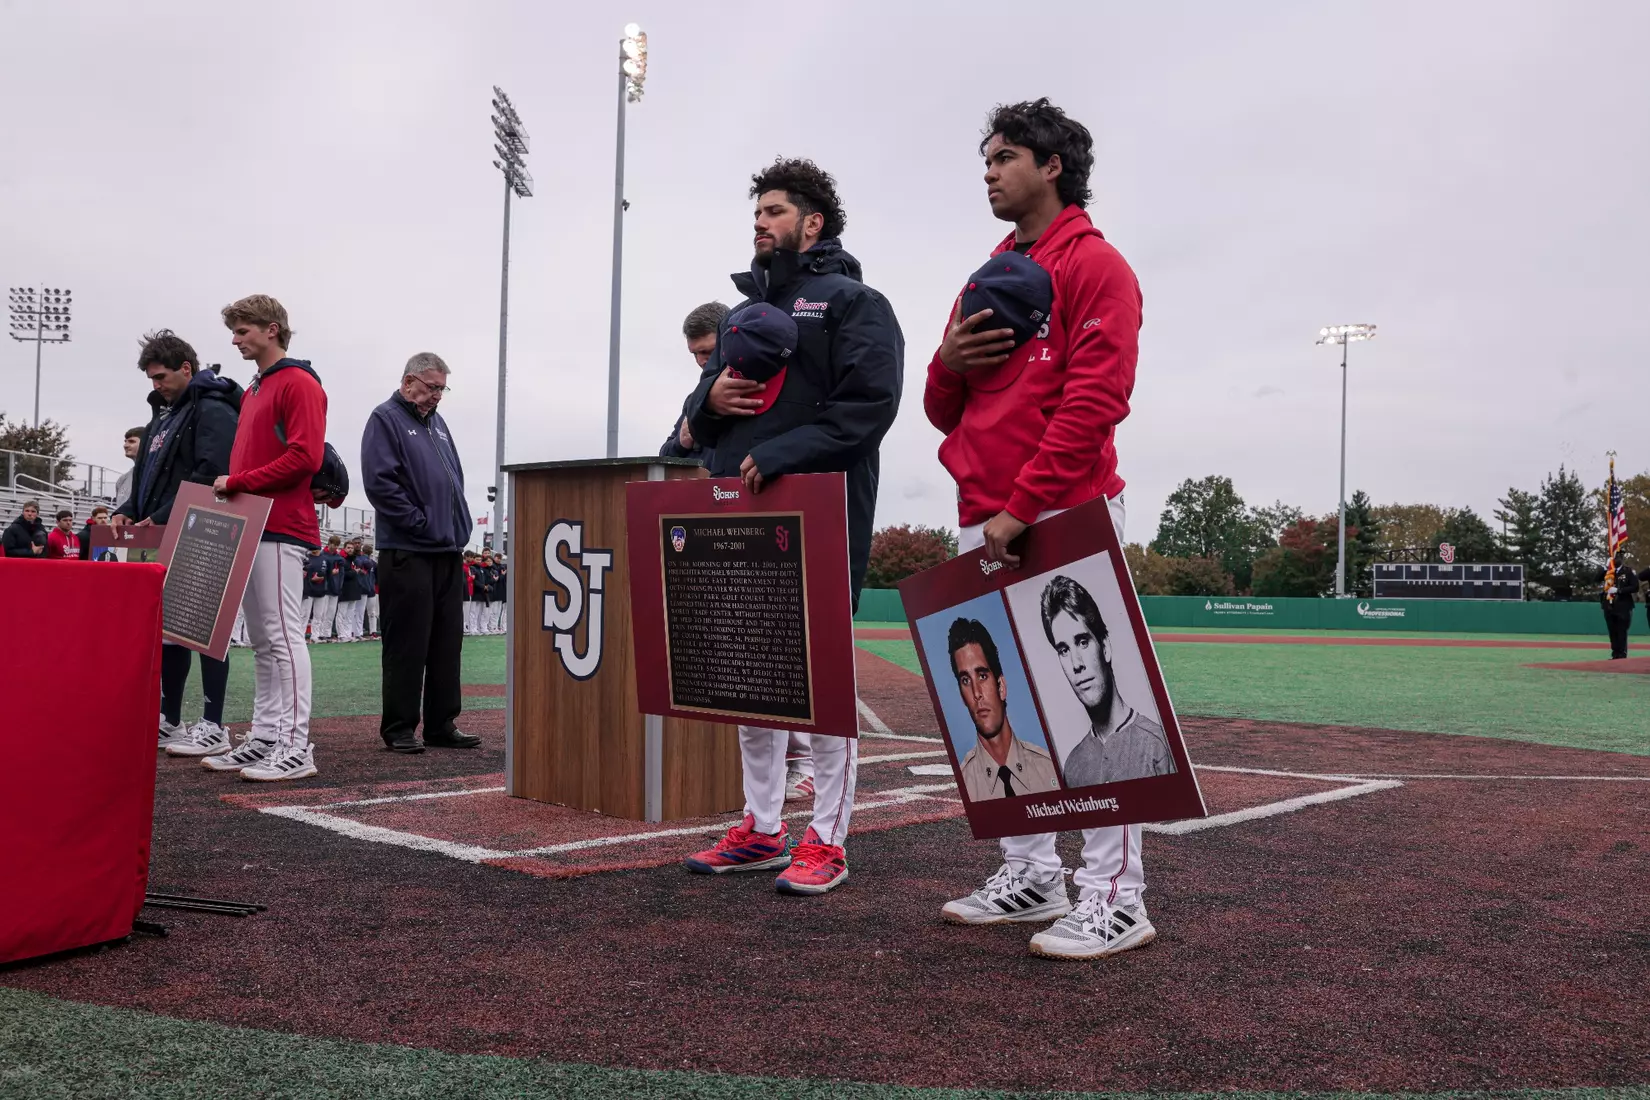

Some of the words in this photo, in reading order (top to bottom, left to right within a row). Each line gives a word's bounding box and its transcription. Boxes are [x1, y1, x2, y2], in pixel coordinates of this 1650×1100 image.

[791, 311, 824, 319] BASEBALL
[1213, 602, 1245, 610] Sullivan
[1246, 602, 1273, 611] Papain
[1025, 799, 1065, 819] Michael
[1064, 796, 1120, 814] Weinburg
